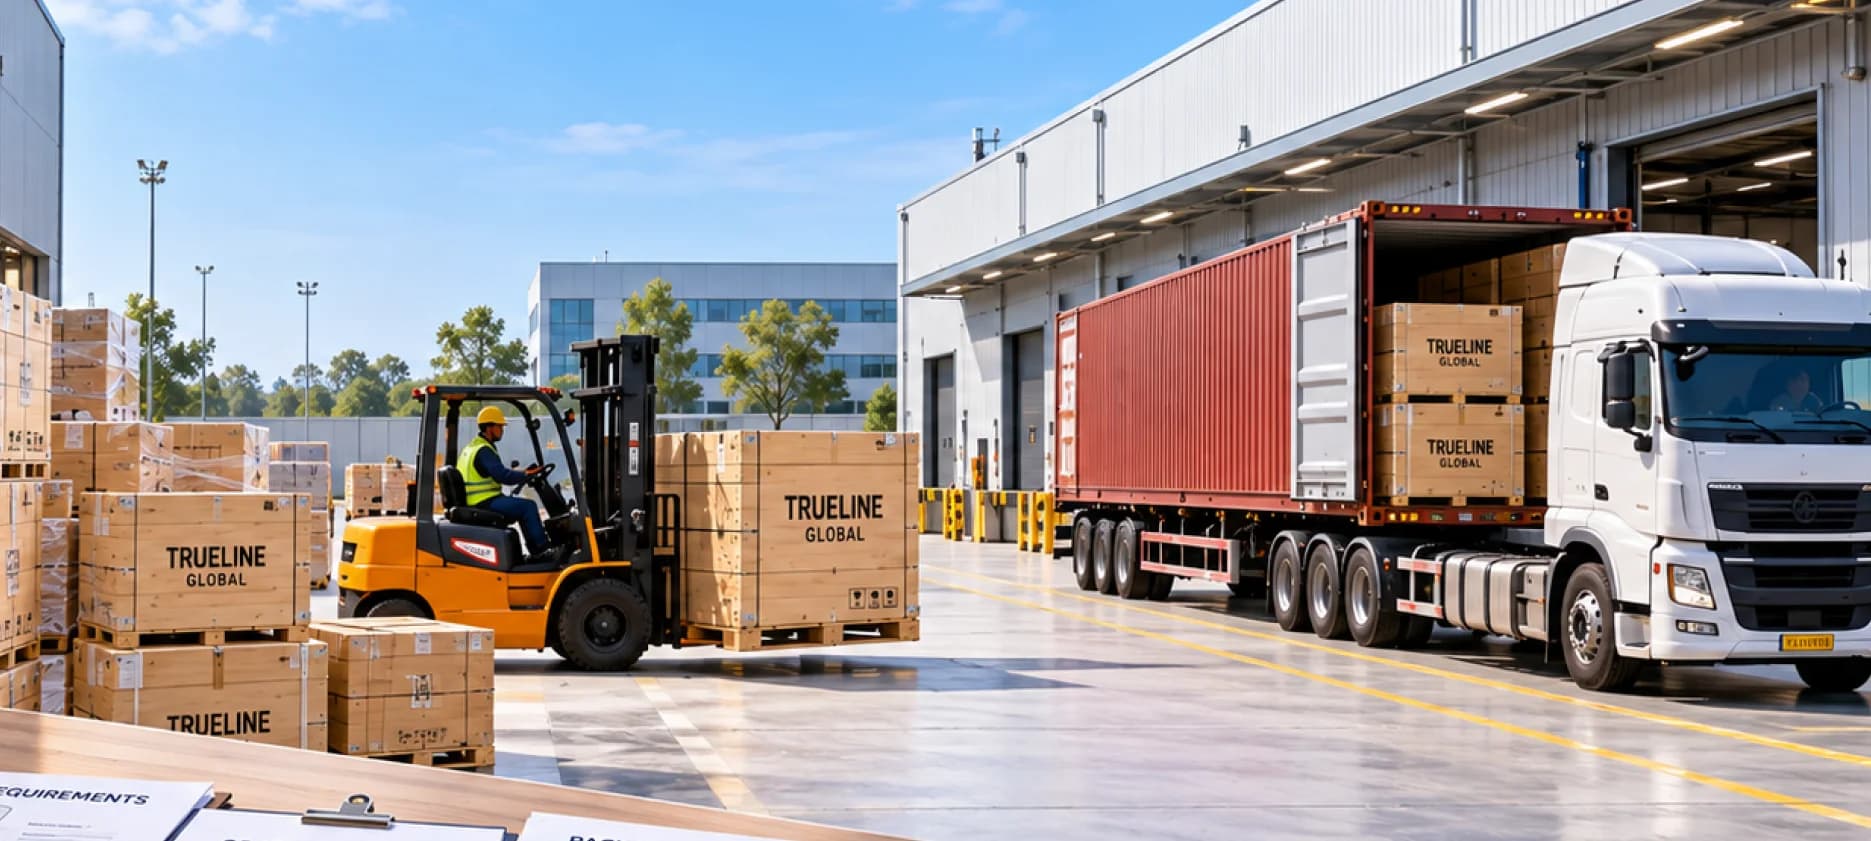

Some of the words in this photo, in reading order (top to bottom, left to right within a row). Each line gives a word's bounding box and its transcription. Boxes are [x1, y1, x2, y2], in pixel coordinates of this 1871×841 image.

[1426, 338, 1493, 355] TRUELINE
[1438, 356, 1481, 368] GLOBAL
[1426, 438, 1494, 456] TRUELINE
[1439, 457, 1482, 469] GLOBAL
[784, 494, 884, 521] TRUELINE
[805, 526, 865, 543] GLOBAL
[165, 545, 266, 569] TRUELINE
[186, 572, 247, 588] GLOBAL
[166, 710, 271, 737] TRUELINE
